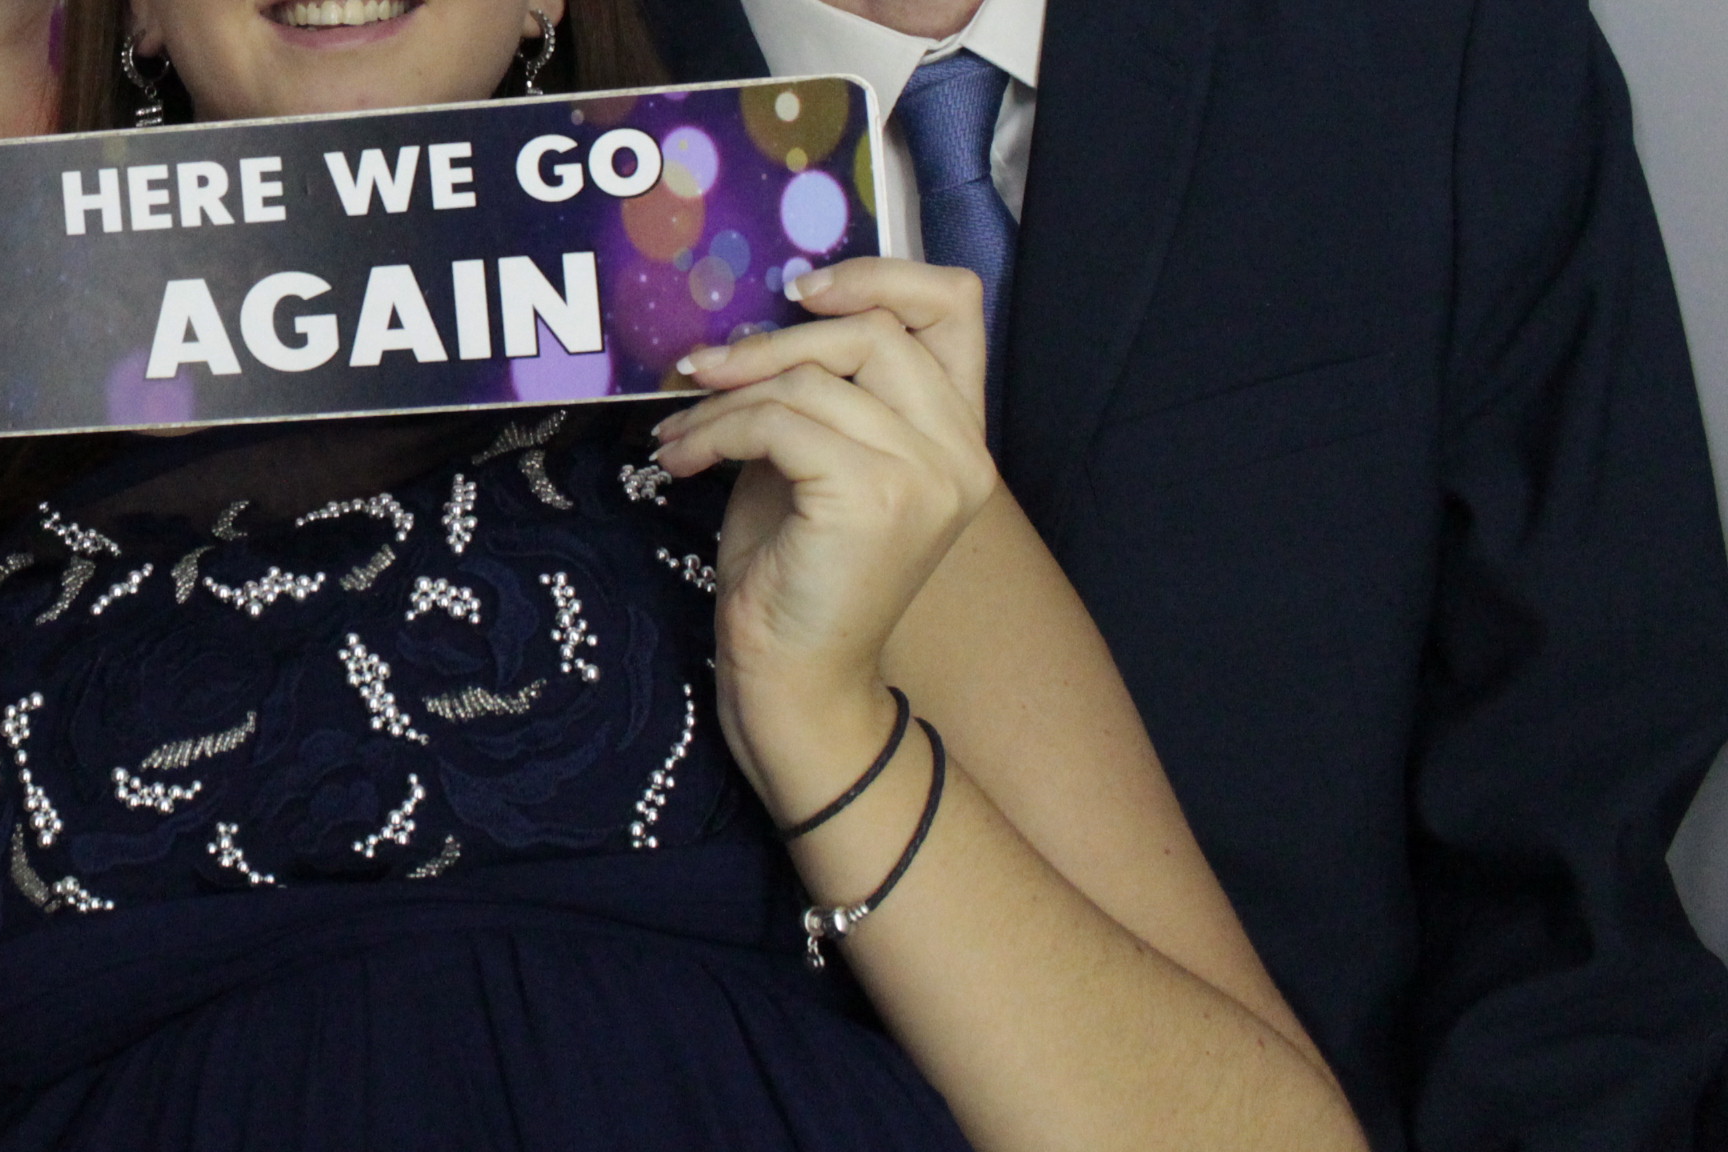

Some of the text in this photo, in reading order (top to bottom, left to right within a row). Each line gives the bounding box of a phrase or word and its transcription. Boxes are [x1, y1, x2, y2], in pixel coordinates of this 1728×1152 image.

[61, 127, 663, 236] HERE WE GO
[144, 251, 605, 380] AGAIN
